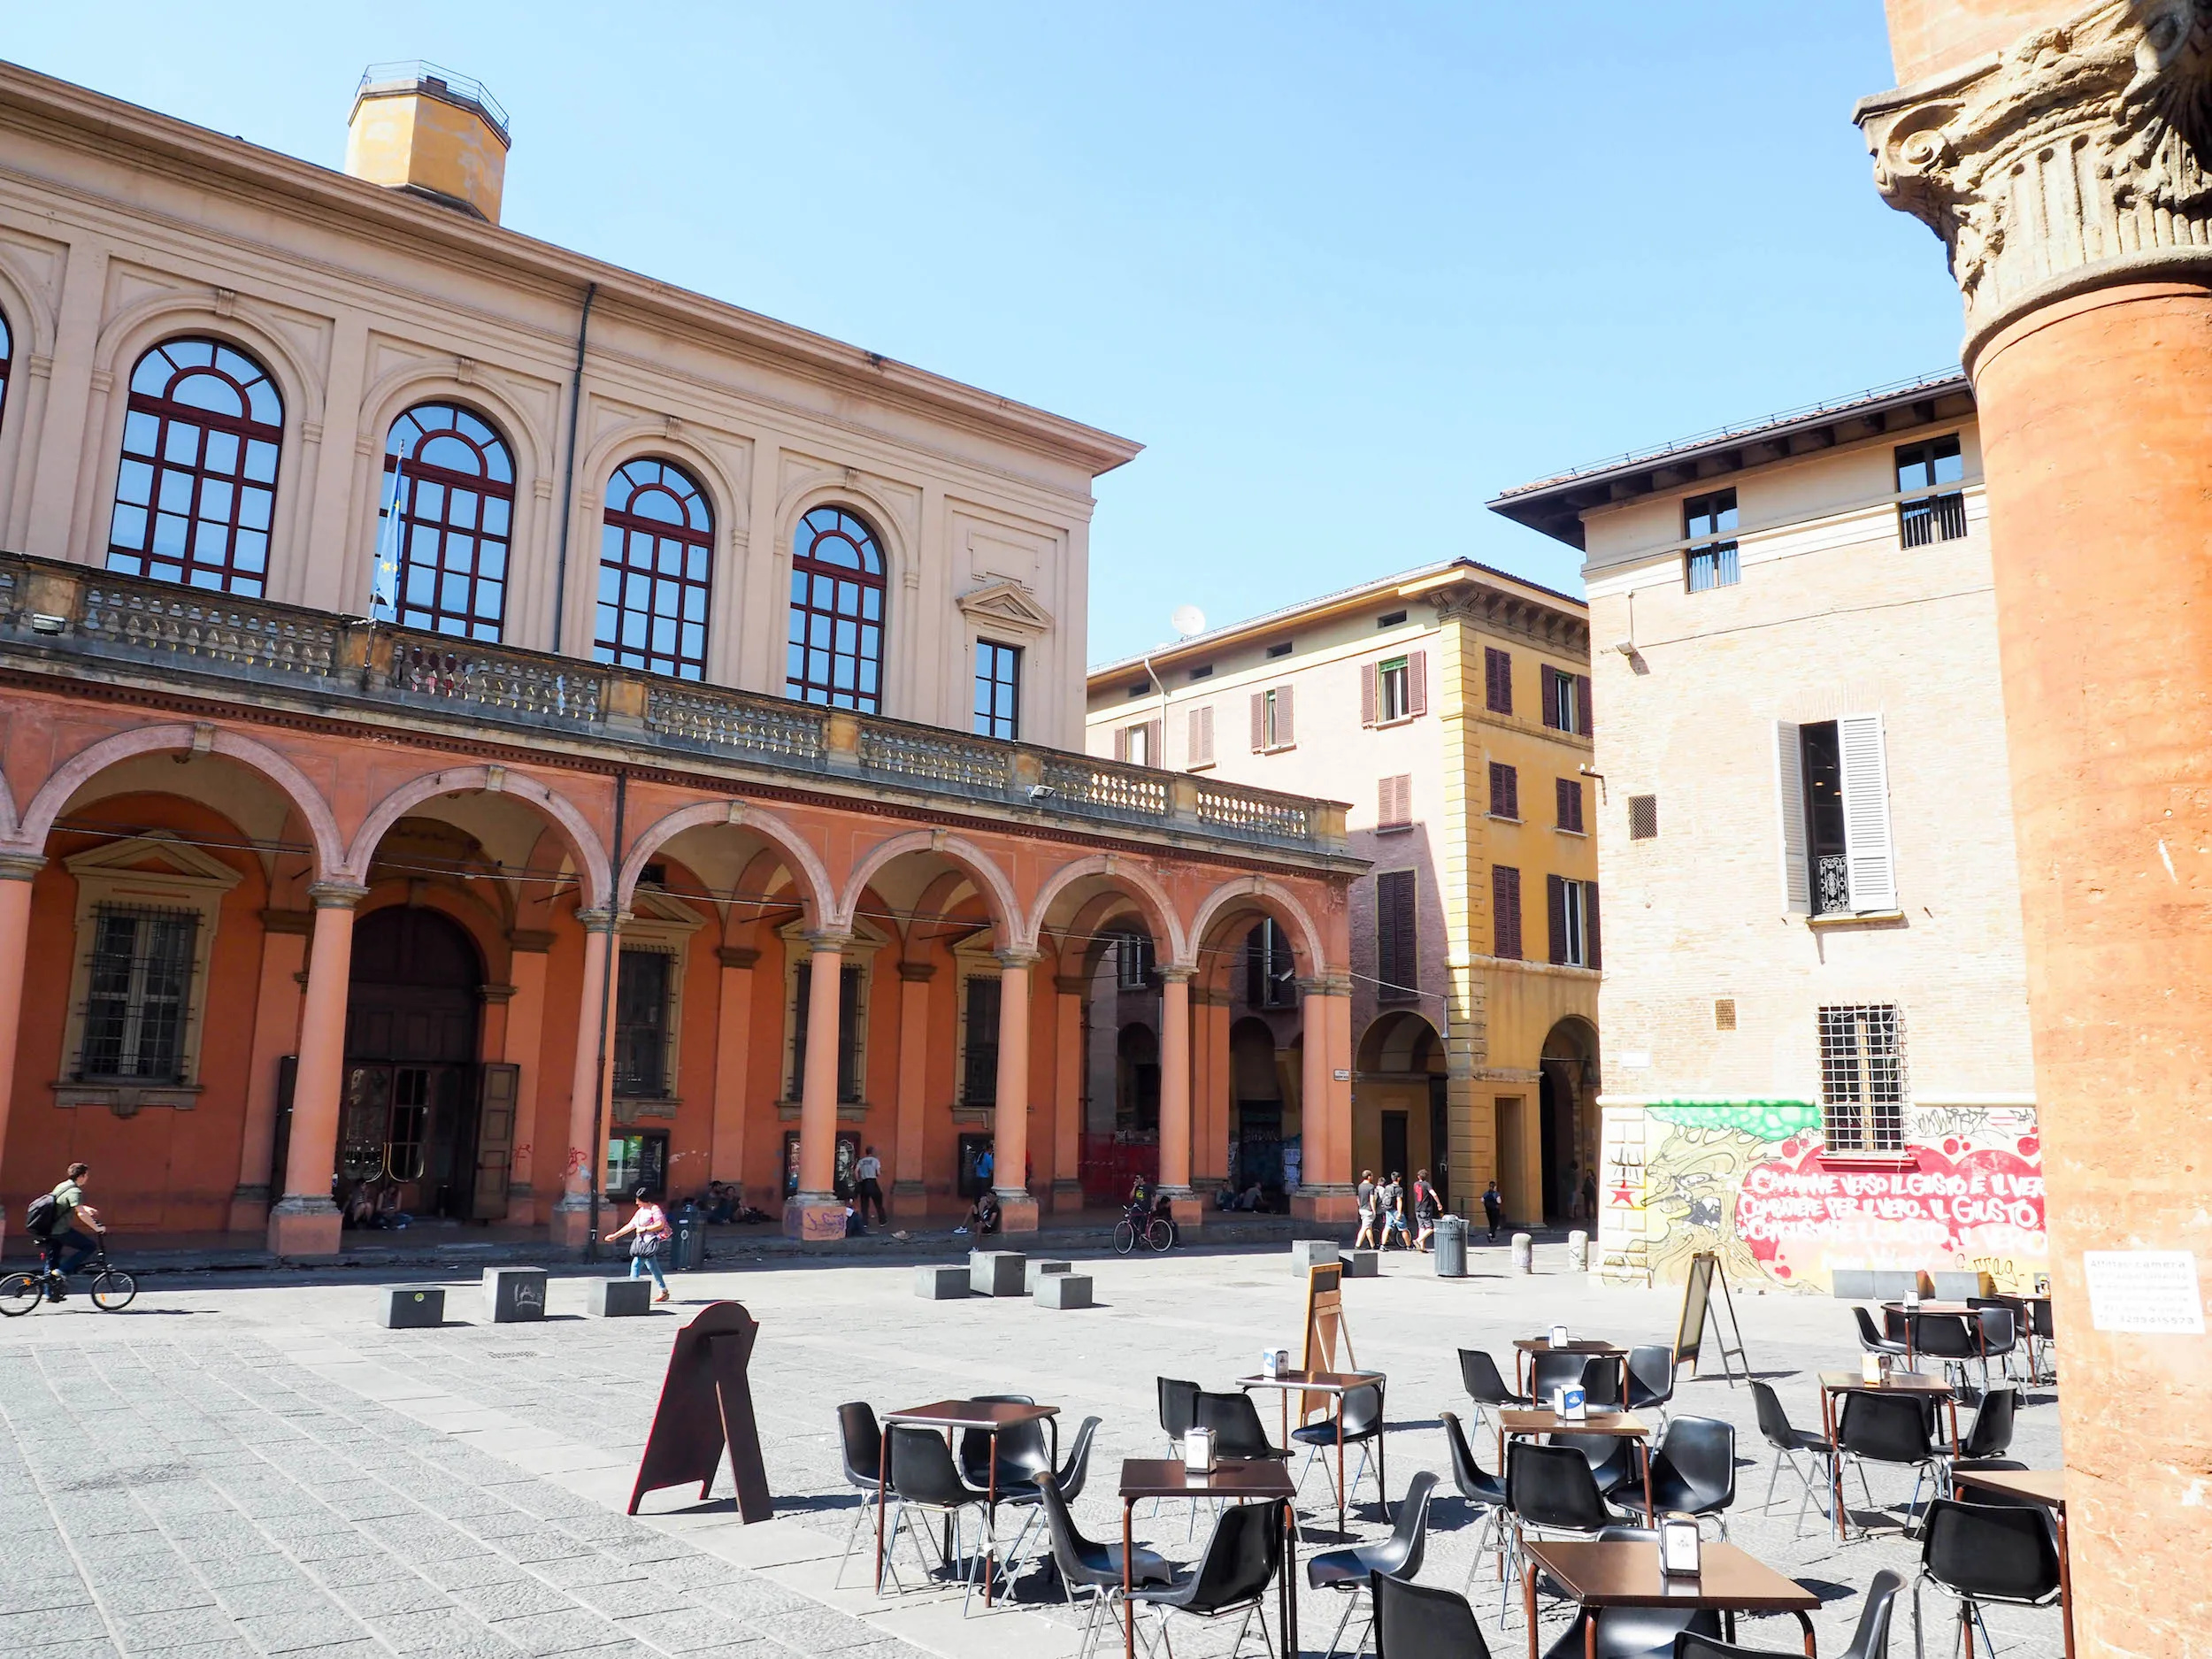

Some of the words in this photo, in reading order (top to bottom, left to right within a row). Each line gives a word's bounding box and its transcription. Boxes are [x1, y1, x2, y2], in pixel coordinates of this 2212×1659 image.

[1841, 1174, 1888, 1195] VERSO
[1891, 1174, 1908, 1195] IL
[1907, 1173, 1968, 1196] GIUSTO
[1991, 1173, 2010, 1196] IL
[1824, 1196, 1859, 1219] PER
[1863, 1198, 1878, 1217] IL
[1930, 1199, 1950, 1220] IL
[1952, 1196, 2039, 1228] GIUSTO
